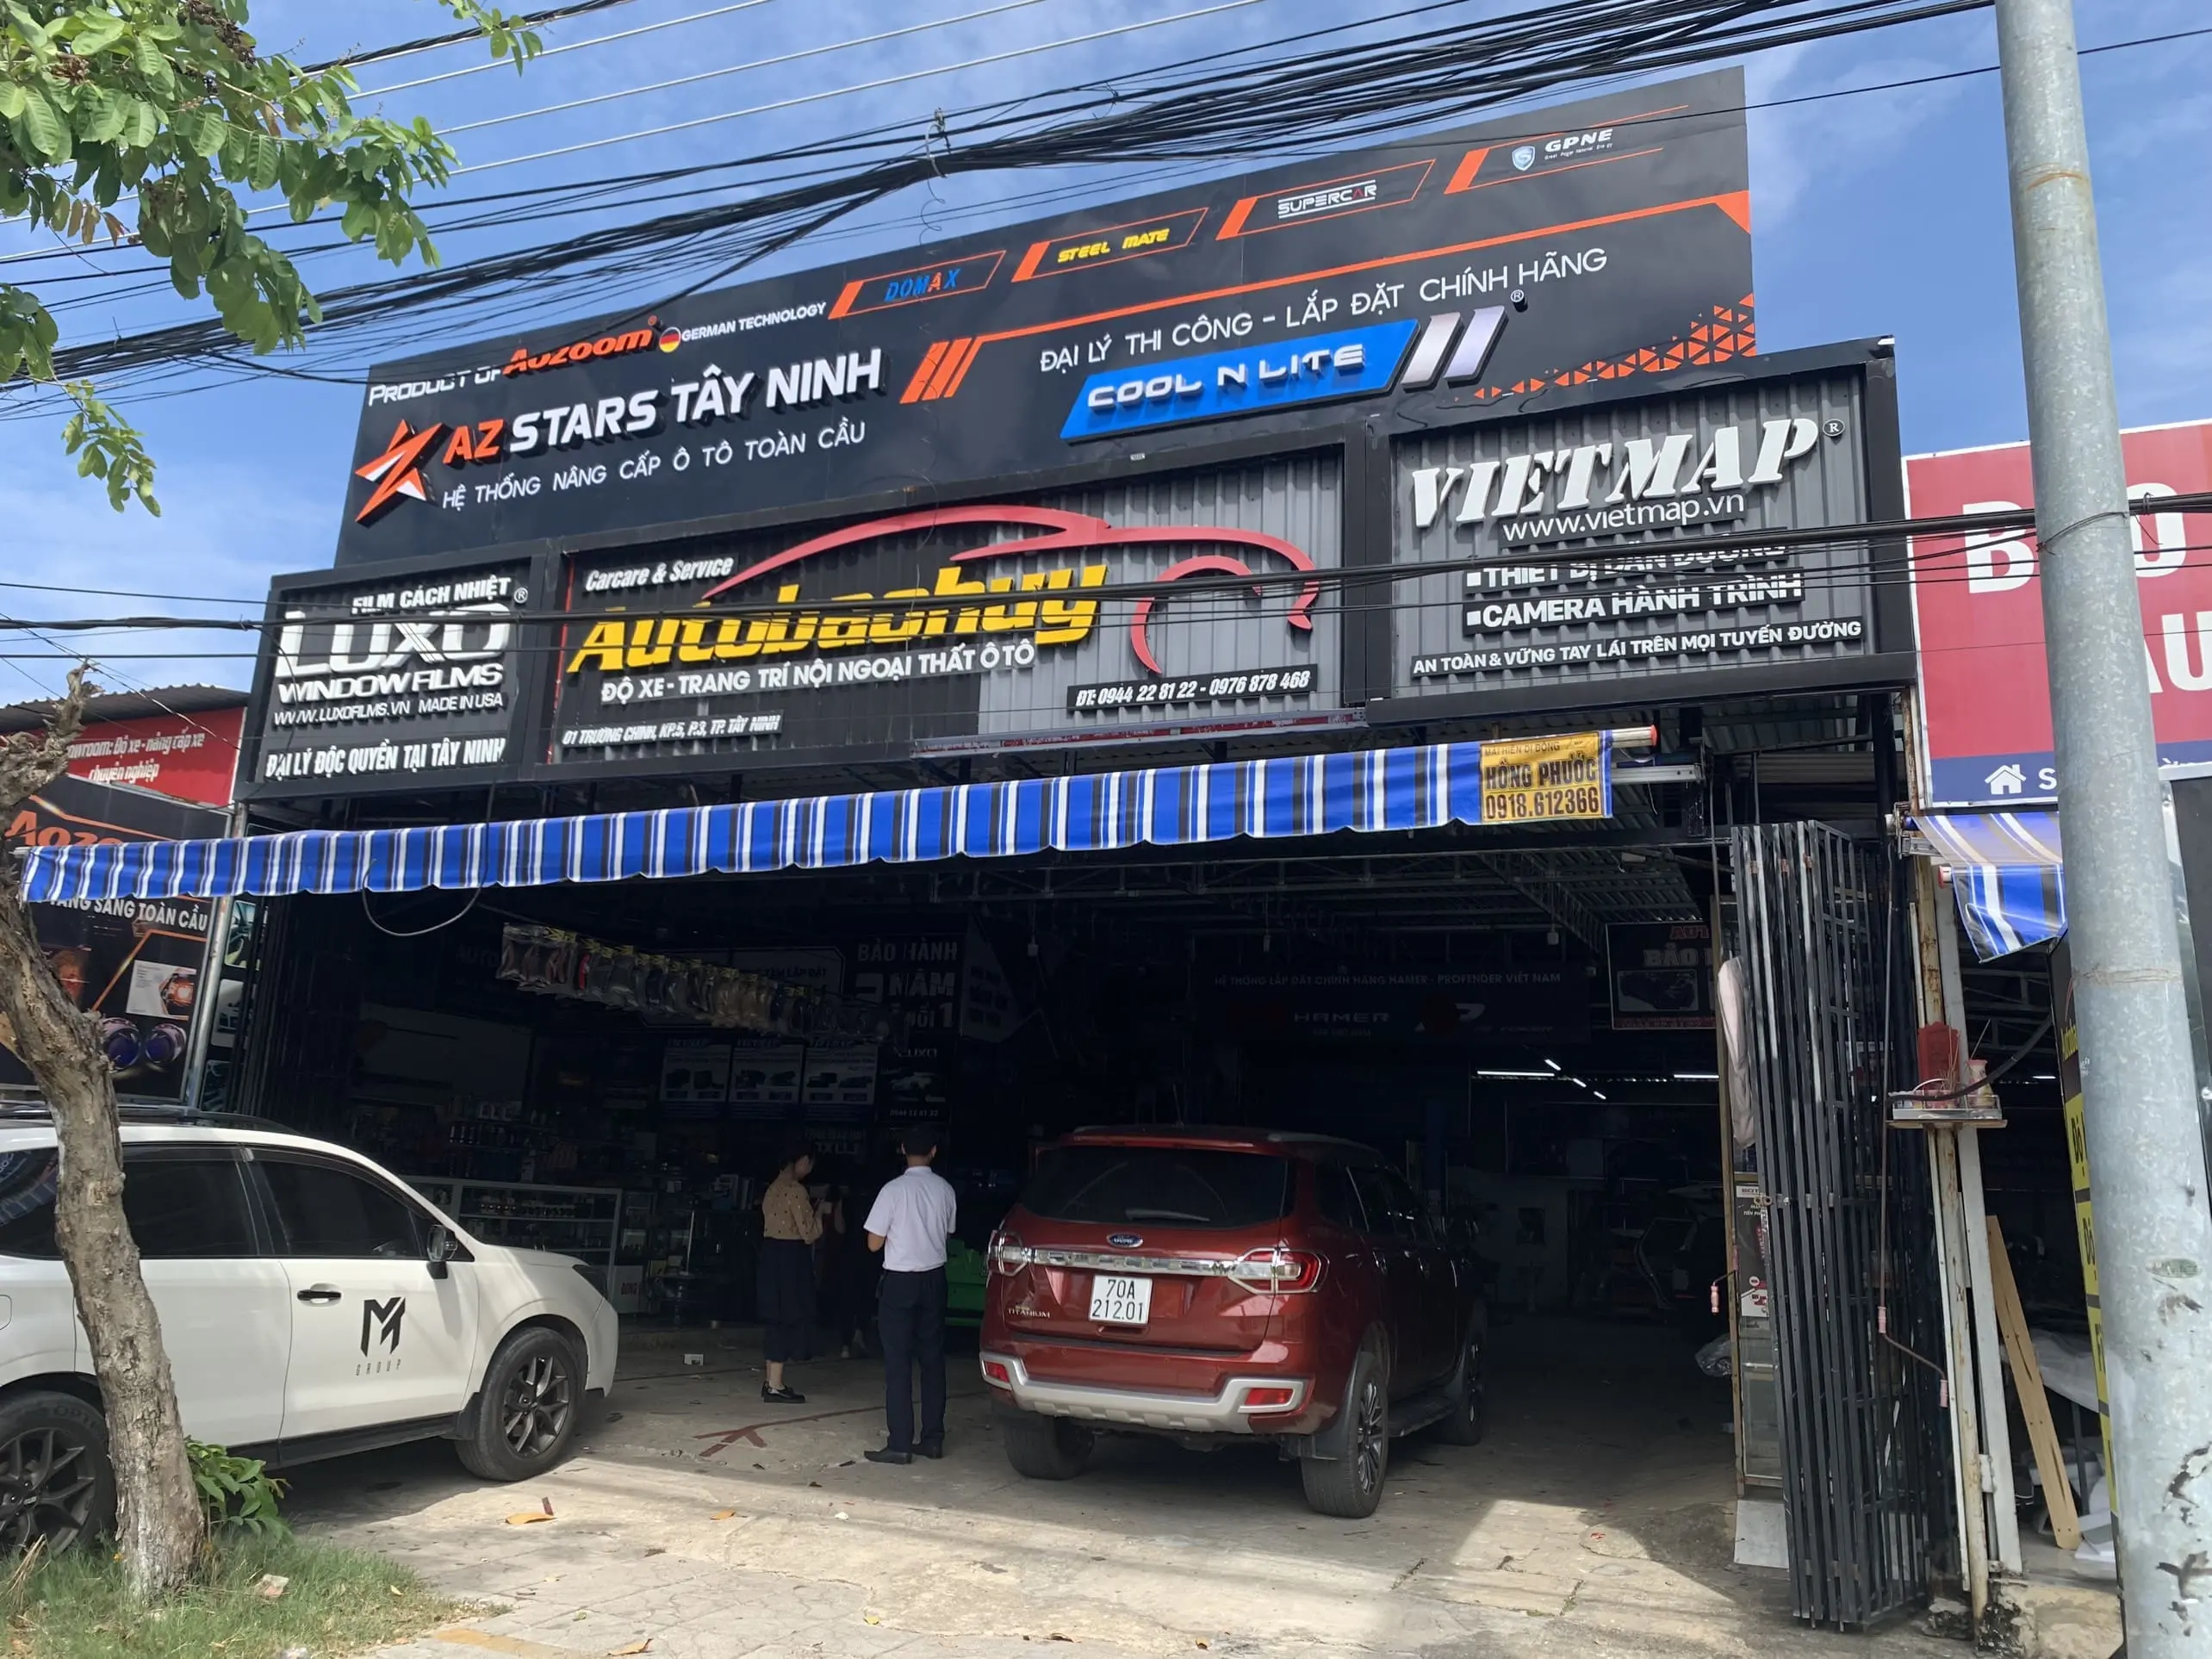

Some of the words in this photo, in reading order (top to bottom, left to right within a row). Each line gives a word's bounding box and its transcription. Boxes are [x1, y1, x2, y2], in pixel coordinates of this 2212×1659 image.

[1544, 128, 1613, 152] GPNE
[1278, 183, 1376, 215] SUPERCAR
[1058, 241, 1110, 264] STEEL
[1122, 228, 1171, 249] MATE
[884, 268, 961, 302] DOMAX
[681, 320, 736, 342] GERMAN
[738, 301, 827, 331] TECHNOLOGY
[1040, 345, 1079, 374] ĐẠI
[1088, 332, 1113, 363] LÝ
[1125, 328, 1162, 355] THI
[1171, 313, 1253, 346] CÔNG
[1286, 289, 1339, 328] LẮP
[1351, 283, 1405, 315] ĐẶT
[1419, 264, 1508, 301] CHÍNH
[1519, 248, 1607, 286] HÃNG
[369, 370, 471, 407] PRODUCT
[1088, 374, 1202, 407] COOL
[1217, 363, 1246, 387] N
[1259, 344, 1364, 380] LITE
[443, 419, 505, 464] AZ
[510, 390, 659, 453] STARS
[671, 363, 755, 423] TÂY
[766, 348, 882, 408] NINH
[442, 484, 467, 511] HỆ
[475, 472, 541, 503] THỐNG
[552, 464, 606, 492] NÂNG
[619, 450, 662, 480] CẤP
[673, 447, 690, 472] Ô
[703, 441, 732, 467] TÔ
[745, 430, 806, 461] TOÀN
[817, 415, 866, 449] CẦU
[1411, 418, 1818, 528] VIETMAP
[1502, 489, 1744, 542] www.vietmap.vn
[586, 569, 650, 592] Carcare
[651, 562, 667, 584] &
[668, 557, 734, 581] Service
[351, 592, 395, 614] FILM
[400, 586, 451, 609] CÁCH
[454, 575, 511, 600] NHIỆT
[1482, 596, 1606, 628] CAMERA
[1612, 585, 1699, 615] HÀNH
[1707, 573, 1802, 606] TRÌNH
[566, 564, 1108, 674] Autobaohuy
[275, 603, 511, 678] LUXO
[1413, 659, 1437, 674] AN
[1440, 652, 1487, 671] TOÀN
[1488, 654, 1502, 668] &
[1503, 643, 1556, 666] VỮNG
[1560, 644, 1591, 660] TAY
[1597, 637, 1626, 657] LÁI
[1630, 633, 1678, 654] TRÊN
[1681, 633, 1716, 651] MỌI
[1720, 624, 1783, 647] TUYẾN
[1788, 620, 1861, 642] ĐƯỜNG
[278, 671, 411, 704] WINDOW
[412, 662, 504, 692] FILMS
[600, 675, 634, 705] ĐỘ
[638, 676, 665, 699] XE
[678, 670, 751, 695] TRANG
[758, 661, 791, 688] TRÍ
[793, 657, 834, 689] NỘI
[838, 649, 912, 682] NGOẠI
[918, 639, 976, 674] THẤT
[979, 642, 1001, 668] Ô
[1003, 638, 1035, 666] TÔ
[1076, 690, 1096, 706] ĐT:
[1098, 687, 1134, 705] 0944
[1137, 684, 1159, 701] 22
[1161, 682, 1177, 699] 81
[1179, 681, 1197, 698] 22
[1209, 674, 1246, 696] 0976
[1249, 673, 1277, 693] 878
[1280, 671, 1310, 689] 468
[418, 696, 457, 714] MADE
[459, 694, 474, 711] IN
[476, 692, 503, 708] USA
[113, 735, 129, 759] Độ
[127, 738, 141, 753] xe
[146, 731, 171, 755] nâng
[172, 726, 191, 753] cấp
[191, 732, 205, 748] xe
[562, 730, 575, 745] 01
[728, 715, 749, 733] TÂY
[749, 714, 781, 731] NINH
[89, 761, 124, 783] chuyên
[124, 758, 159, 783] nghiệp
[265, 753, 292, 781] ĐẠI
[293, 748, 313, 775] LÝ
[314, 745, 345, 778] ĐỘC
[347, 738, 397, 774] QUYỀN
[402, 743, 427, 773] TẠI
[431, 737, 460, 767] TÂY
[463, 737, 506, 764] NINH
[1486, 757, 1532, 789] HỒNG
[1538, 749, 1598, 786] PHƯỚC
[1485, 786, 1600, 819] 0918.612366
[138, 901, 177, 926] TOÀN
[178, 904, 208, 931] CẦU
[858, 937, 896, 961] BẢO
[1106, 1279, 1135, 1300] 70A
[1091, 1299, 1144, 1321] 212.01
